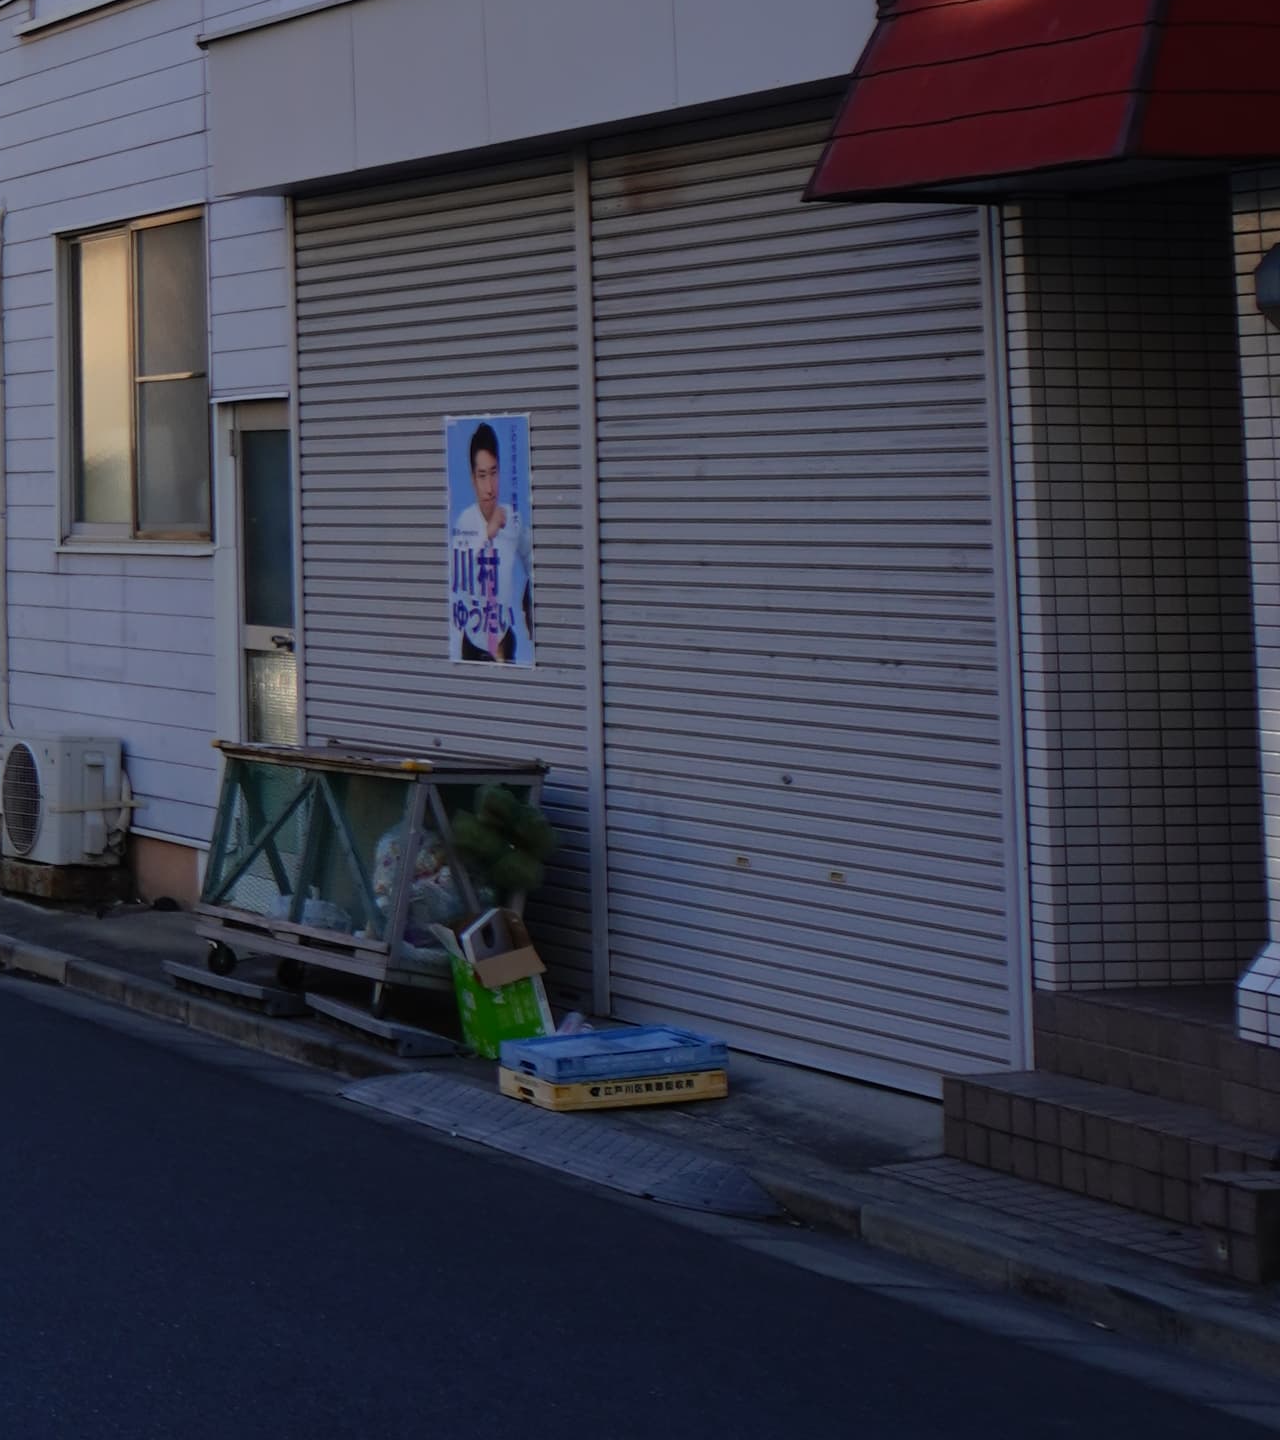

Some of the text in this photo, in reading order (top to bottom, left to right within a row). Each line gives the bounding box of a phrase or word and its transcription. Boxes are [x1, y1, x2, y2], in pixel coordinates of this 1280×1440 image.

[452, 546, 500, 598] 川村
[452, 601, 516, 635] ゆうだい
